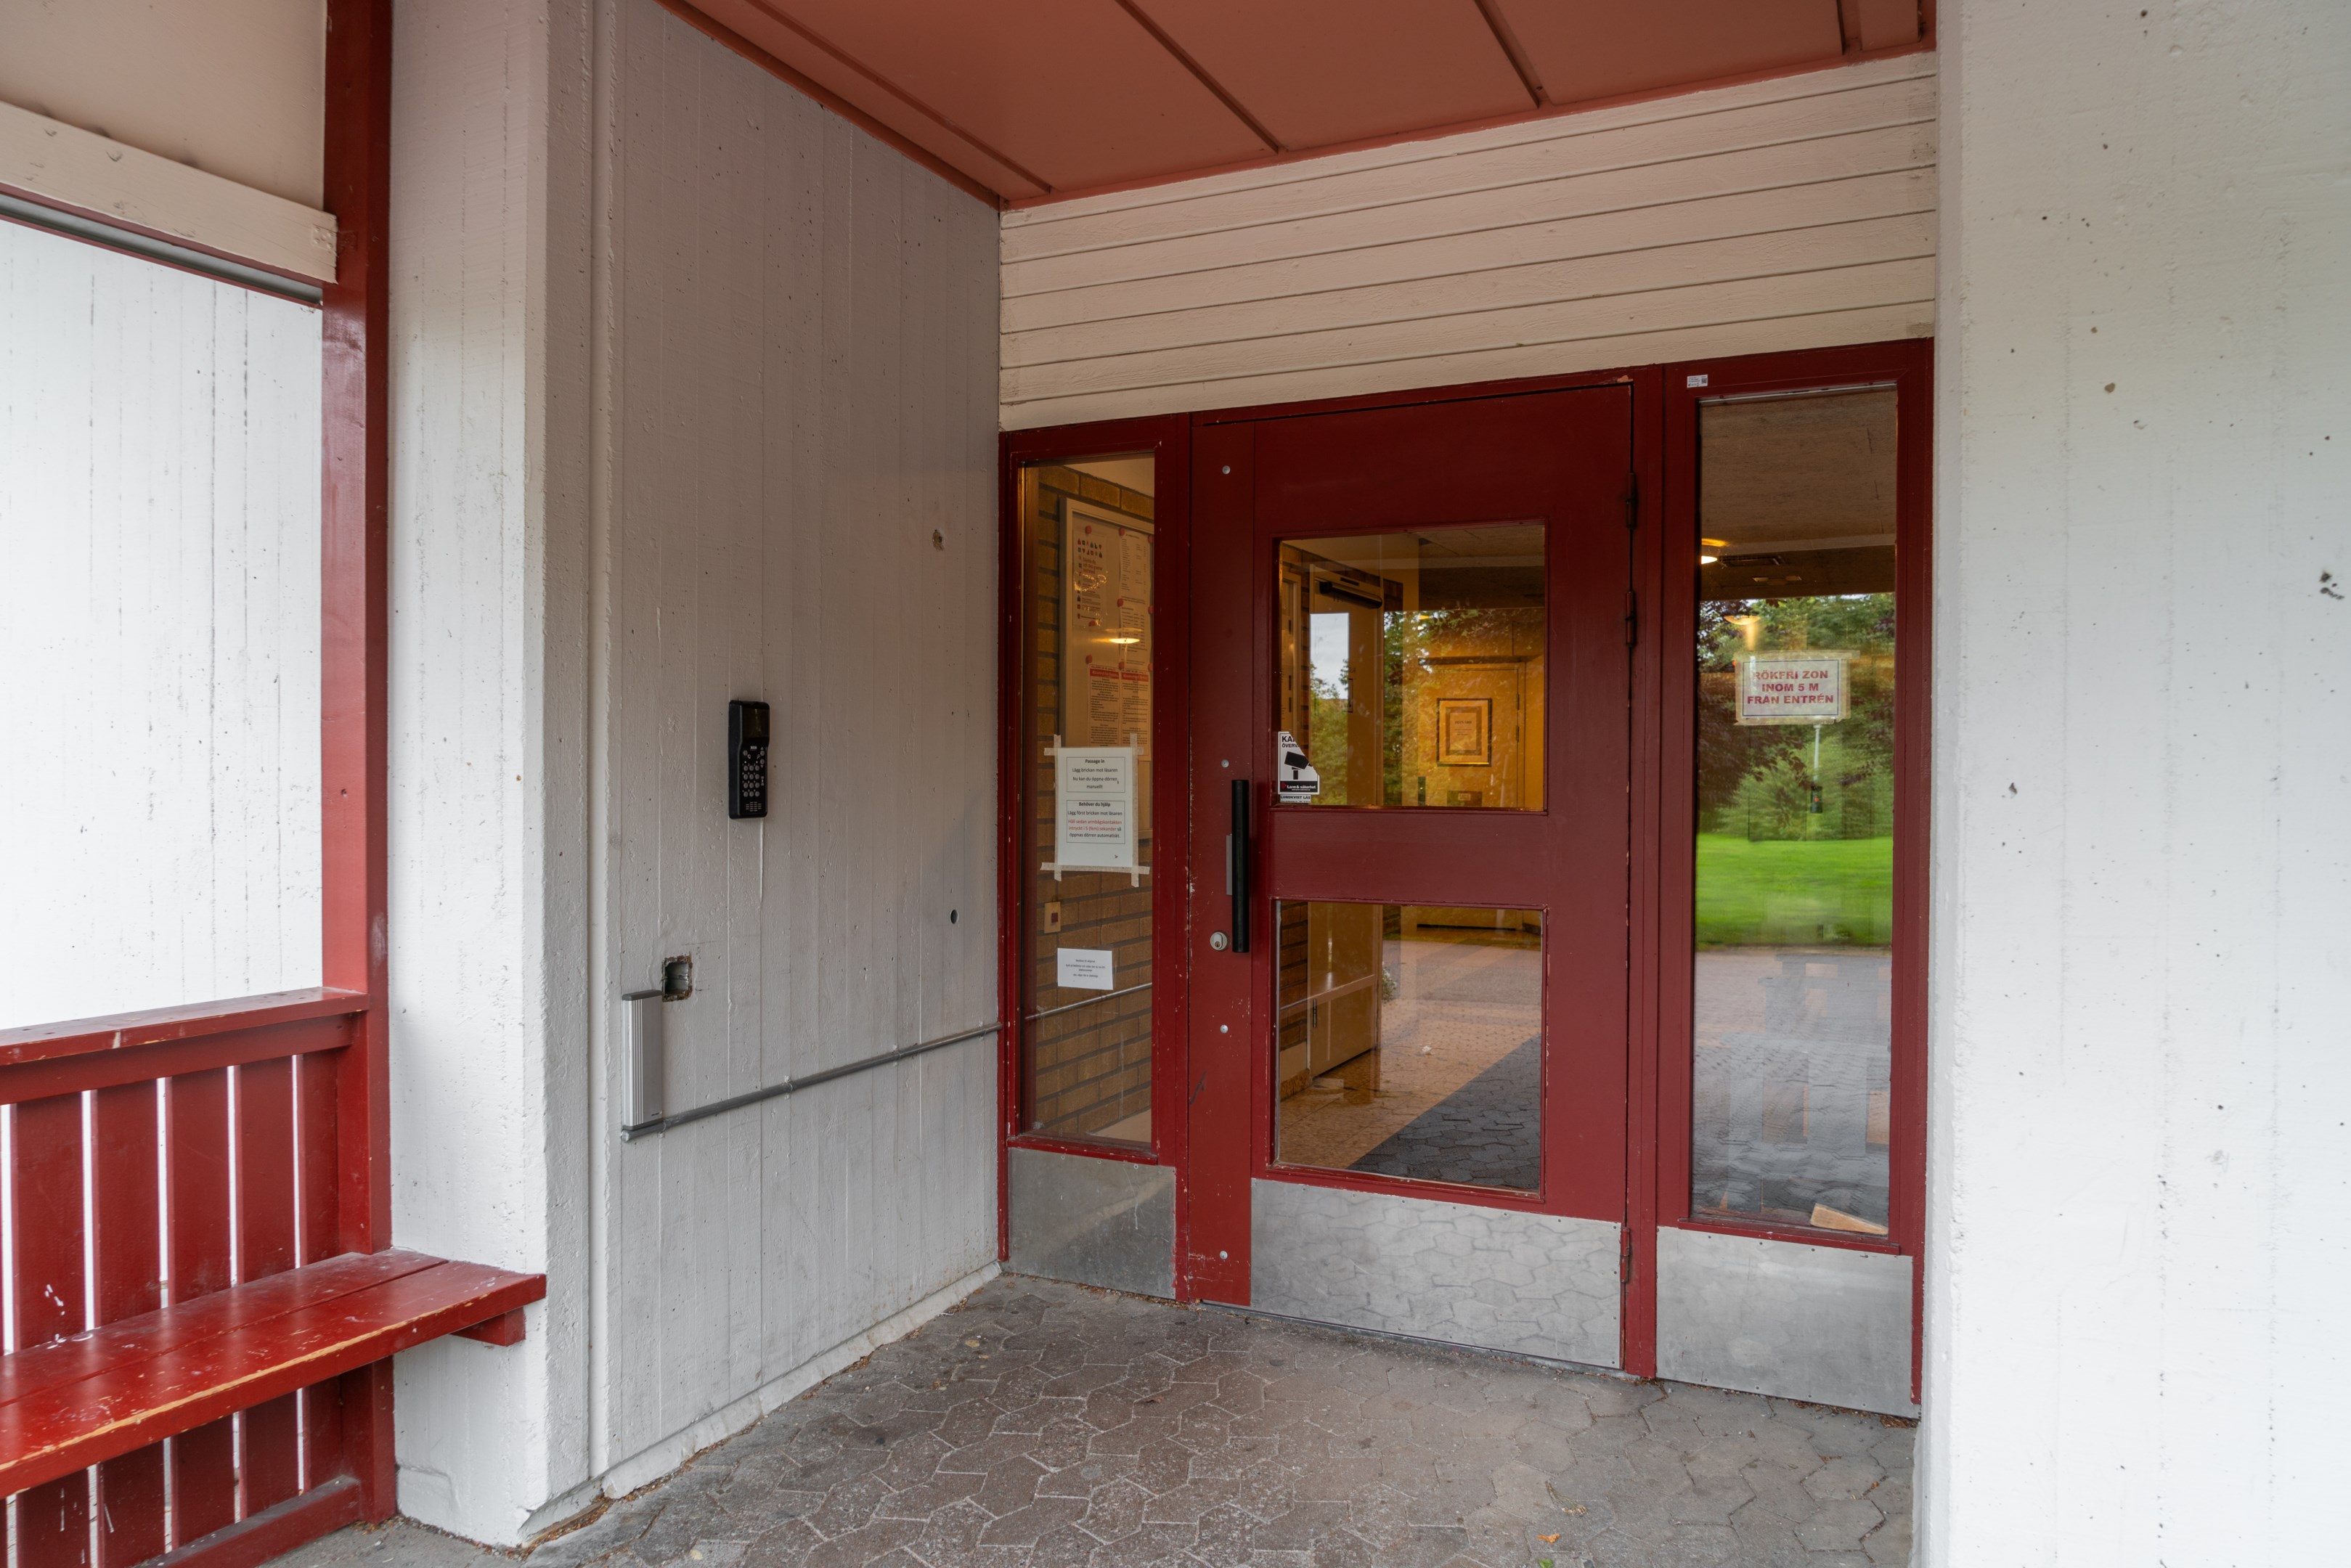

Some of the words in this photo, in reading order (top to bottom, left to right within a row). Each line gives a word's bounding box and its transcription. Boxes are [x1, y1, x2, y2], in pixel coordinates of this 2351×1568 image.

[1754, 670, 1798, 679] RÖKFRI
[1748, 695, 1780, 704] FRÅN
[1784, 693, 1833, 703] ENTRÉN
